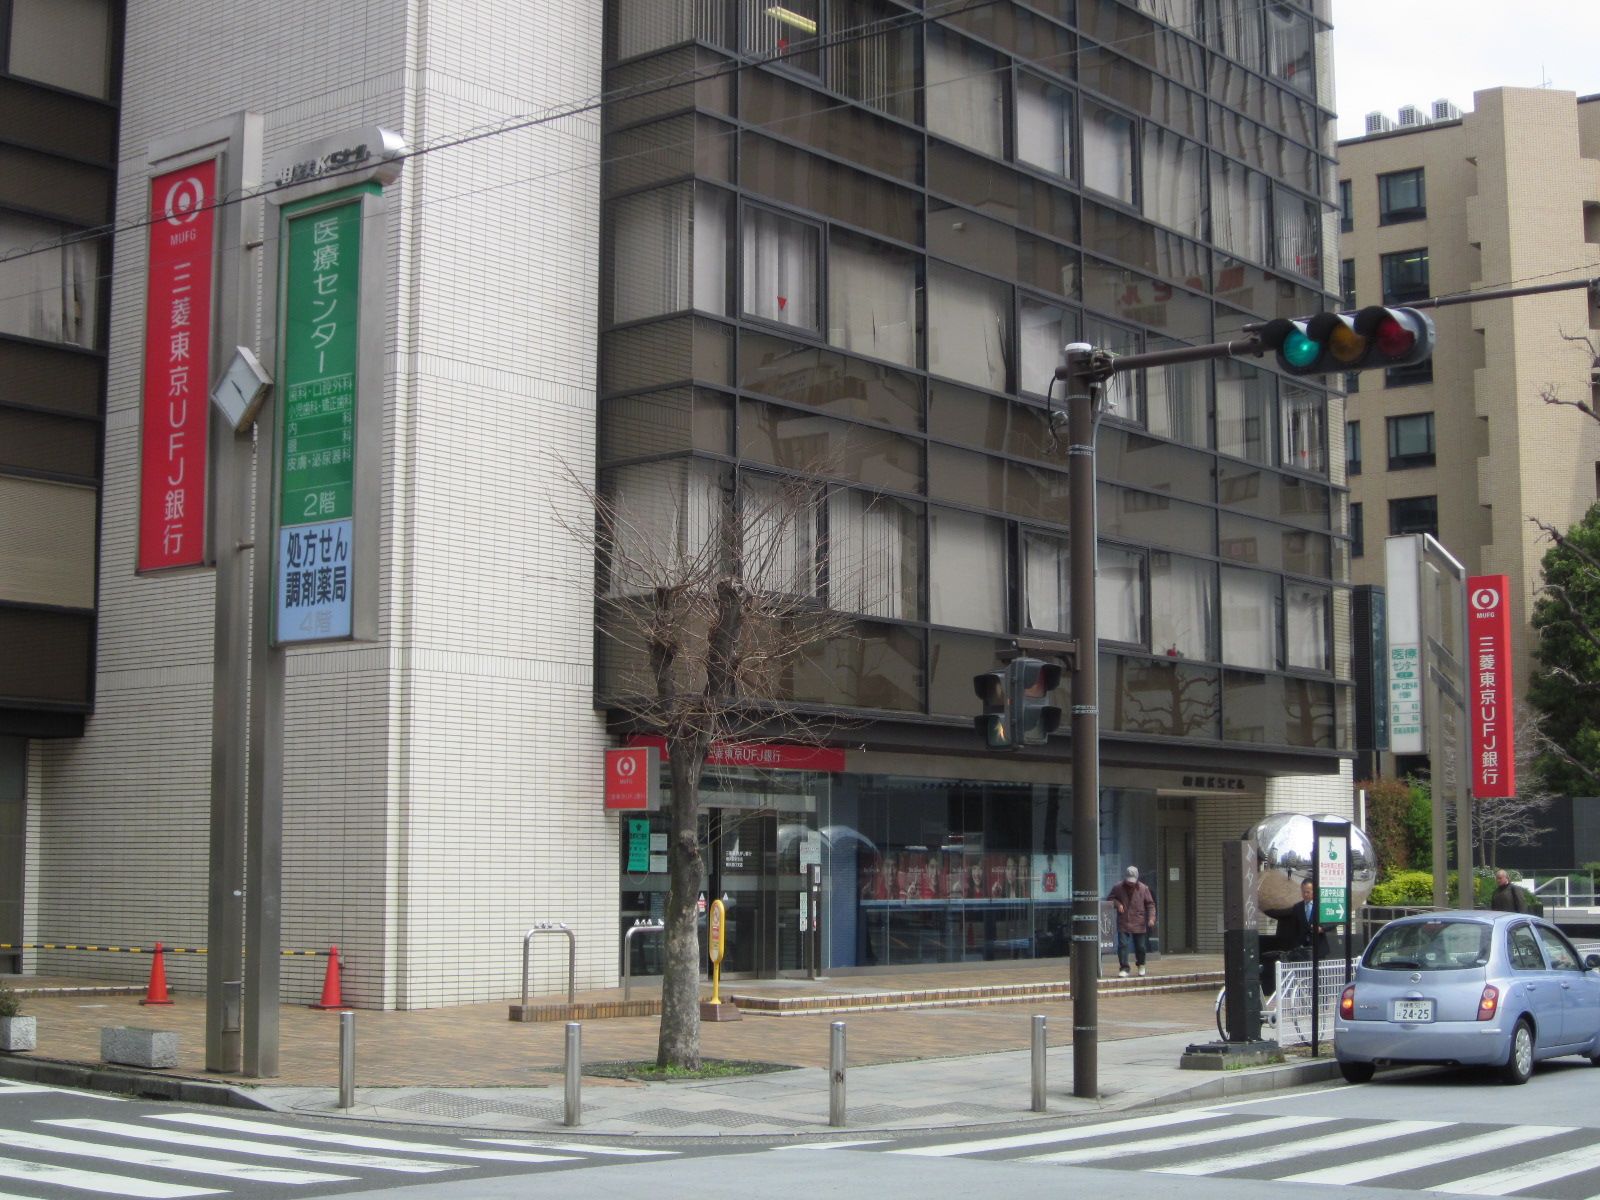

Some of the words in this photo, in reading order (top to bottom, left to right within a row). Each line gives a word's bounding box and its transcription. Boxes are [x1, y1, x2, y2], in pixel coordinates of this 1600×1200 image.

[169, 229, 197, 245] MUFG
[310, 216, 340, 375] 医療センター
[163, 261, 192, 556] 三菱東京UFJ銀行
[303, 490, 336, 517] 2階
[286, 527, 348, 569] 処方せん
[285, 566, 347, 609] 調剤薬局
[1476, 611, 1495, 619] MUFG
[1391, 648, 1417, 660] 医療
[1479, 636, 1499, 785] 三菱東京UFJ銀行
[1402, 1009, 1429, 1020] 24-25
